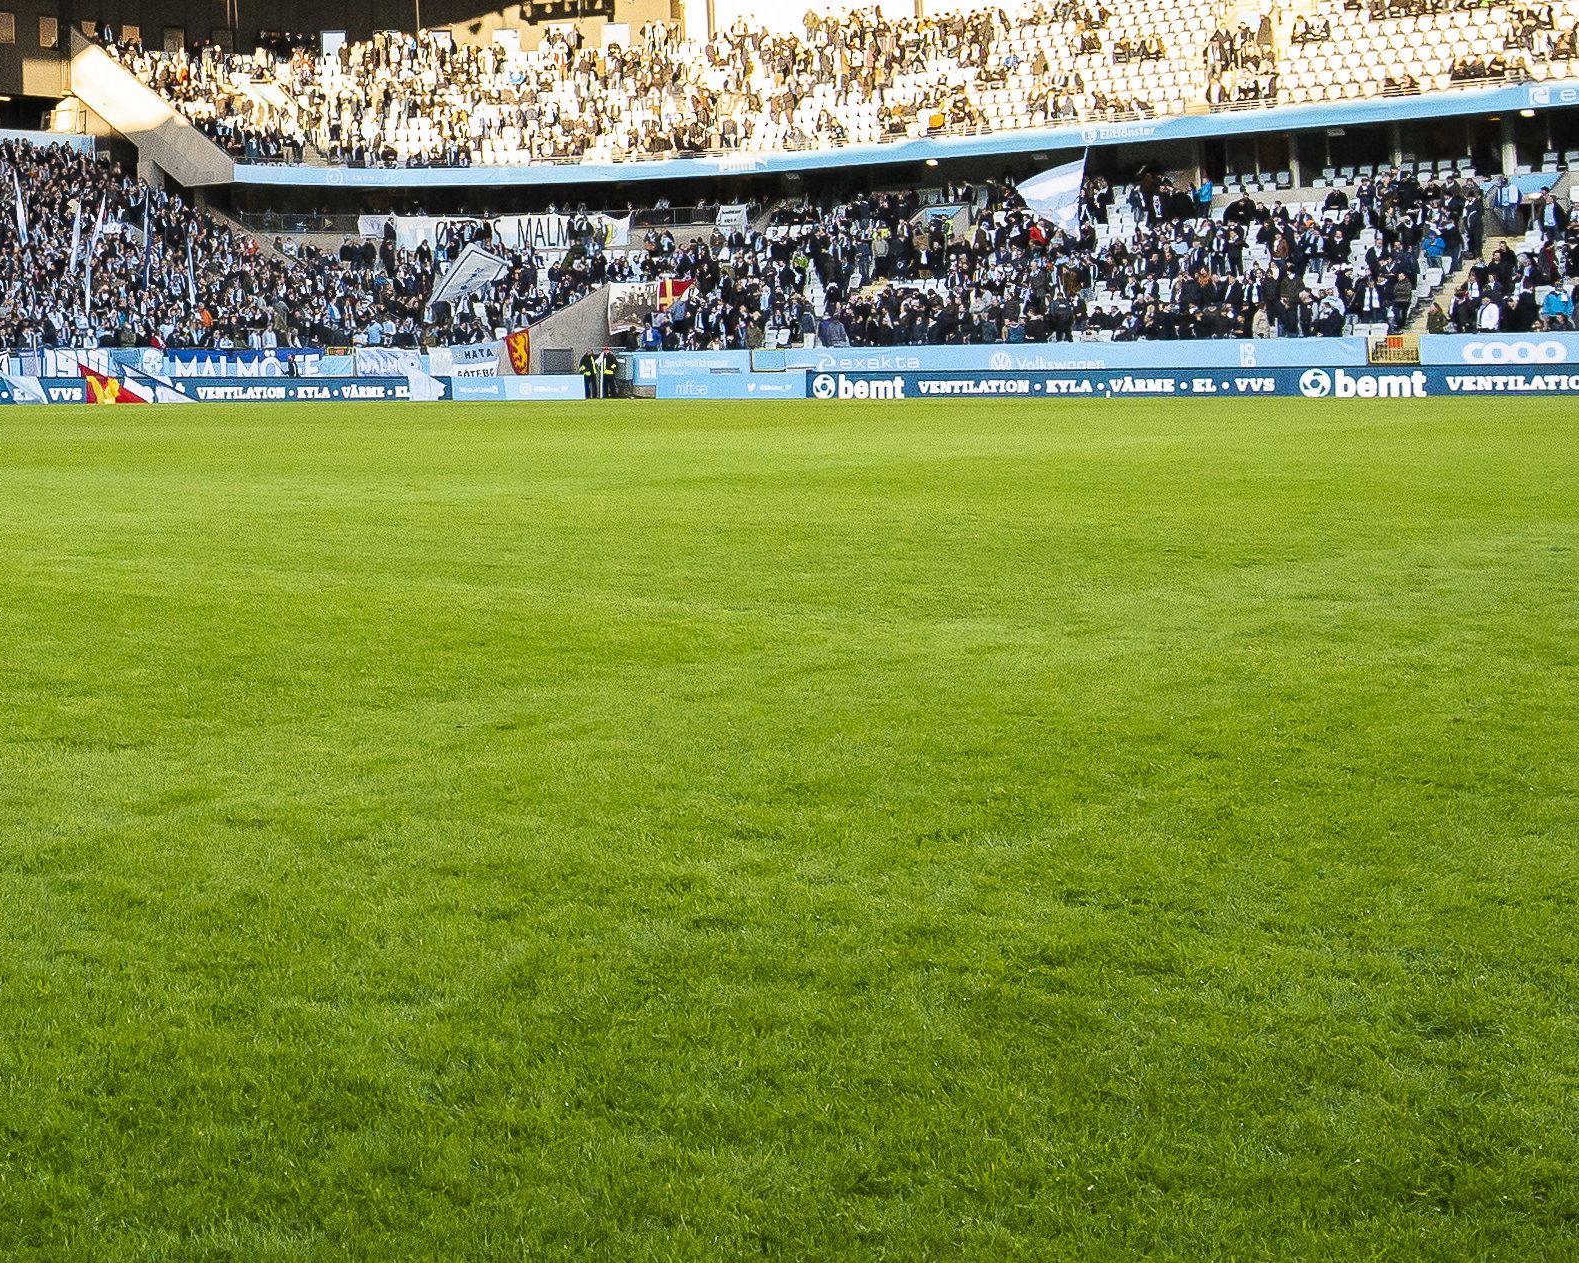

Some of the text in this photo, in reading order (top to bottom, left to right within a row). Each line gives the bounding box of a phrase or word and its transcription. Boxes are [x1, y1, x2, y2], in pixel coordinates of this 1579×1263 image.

[840, 354, 920, 369] exakta
[838, 373, 905, 399] bemt
[918, 380, 1030, 394] VENTILATION
[1045, 379, 1093, 393] KYLA
[1191, 378, 1217, 392] EL
[1235, 377, 1275, 392] VVS
[1334, 368, 1428, 397] bemt
[48, 387, 83, 401] VVS
[196, 386, 286, 399] VENTILATION
[297, 386, 331, 400] KYLA
